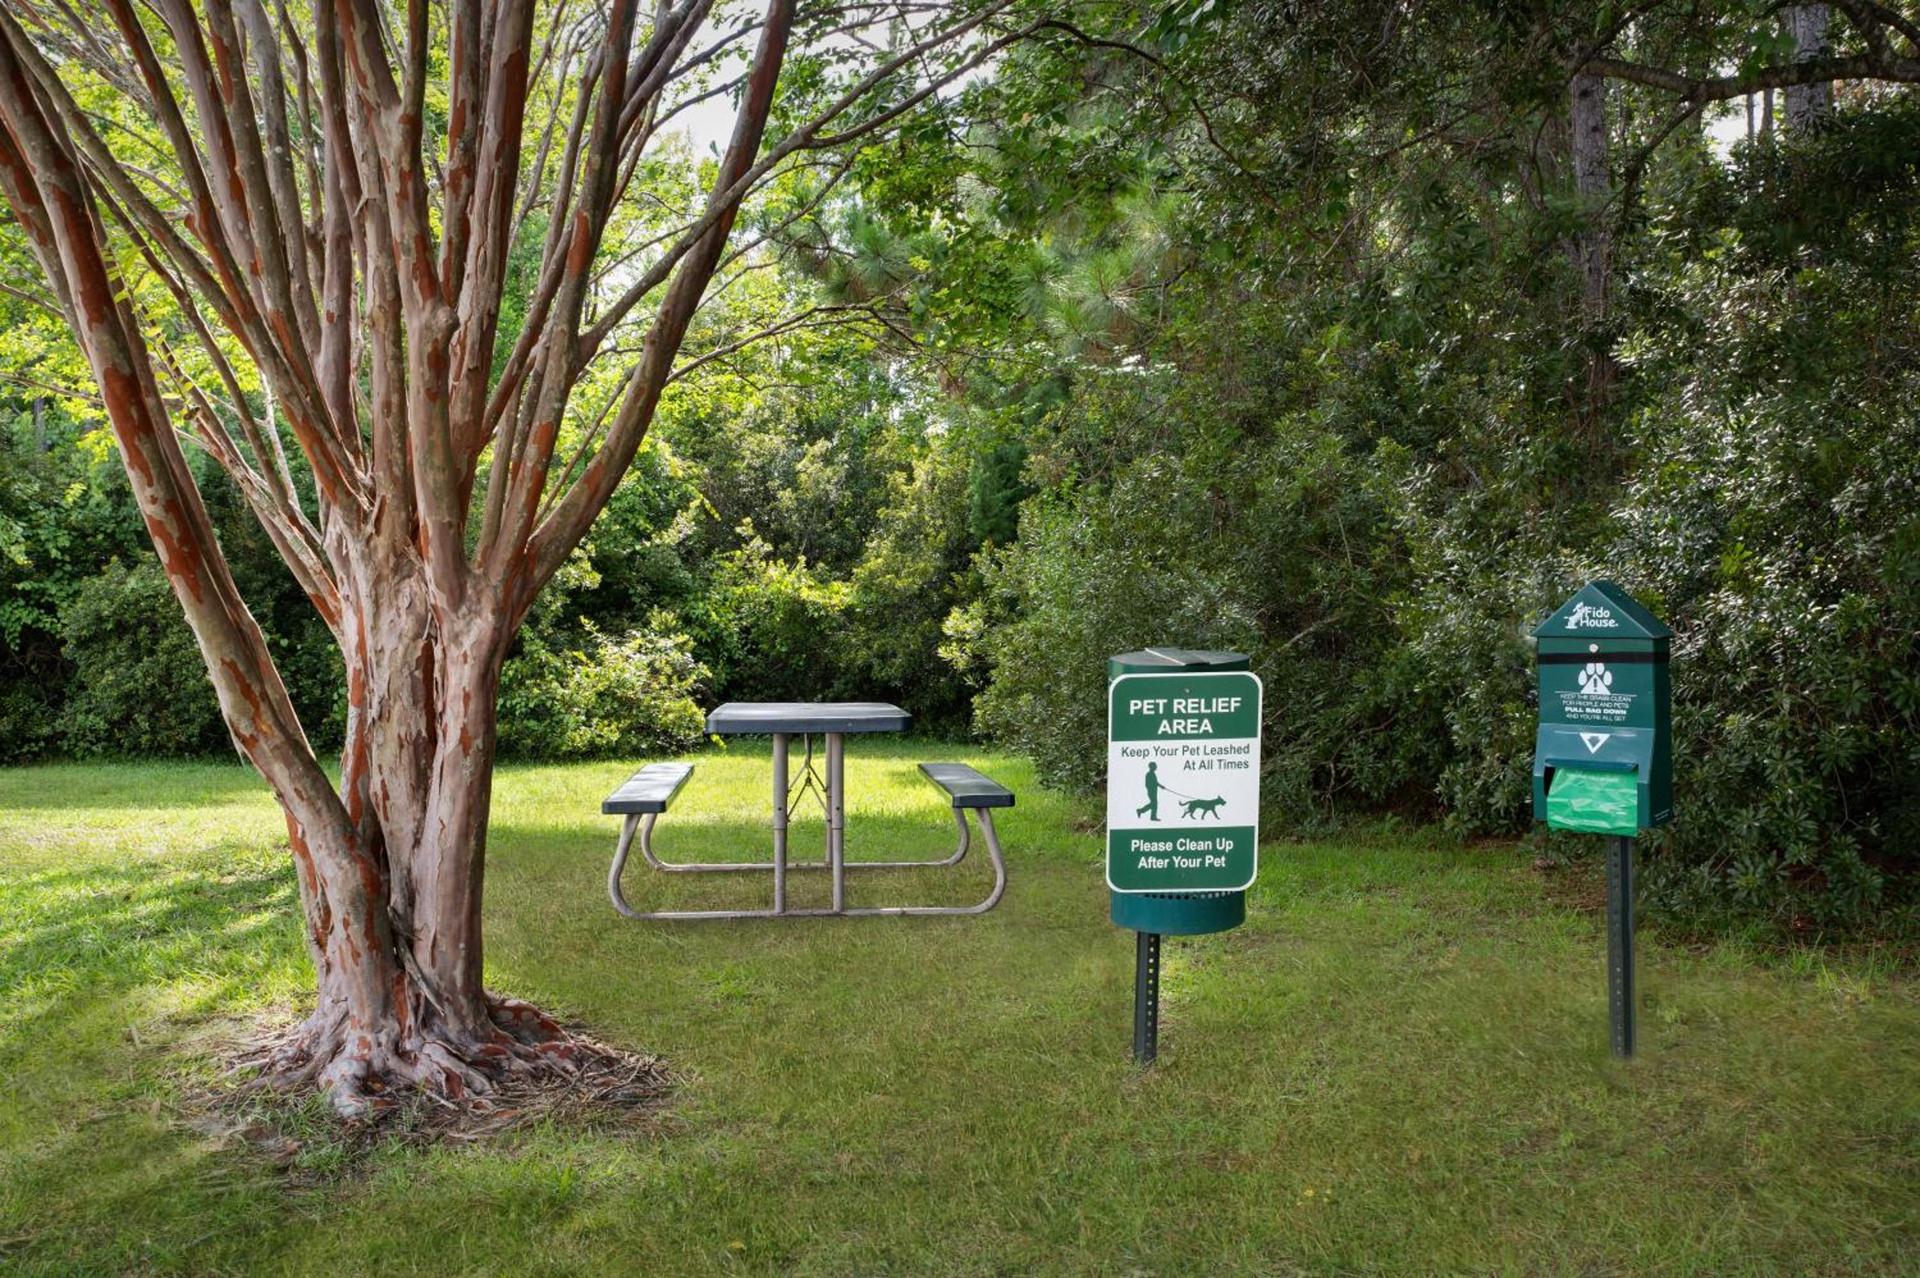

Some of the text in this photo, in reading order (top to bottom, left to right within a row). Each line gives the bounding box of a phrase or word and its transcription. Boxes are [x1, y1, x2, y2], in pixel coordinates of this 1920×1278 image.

[1584, 606, 1610, 618] Fido
[1580, 616, 1616, 627] House
[1129, 697, 1242, 715] PET RELIEF
[1157, 718, 1213, 734] AREA
[1121, 743, 1250, 758] Keep Your Pet Leashed
[1183, 759, 1249, 770] At All Times
[1131, 837, 1234, 853] Please Clean Up
[1138, 855, 1226, 869] After Your Pet
